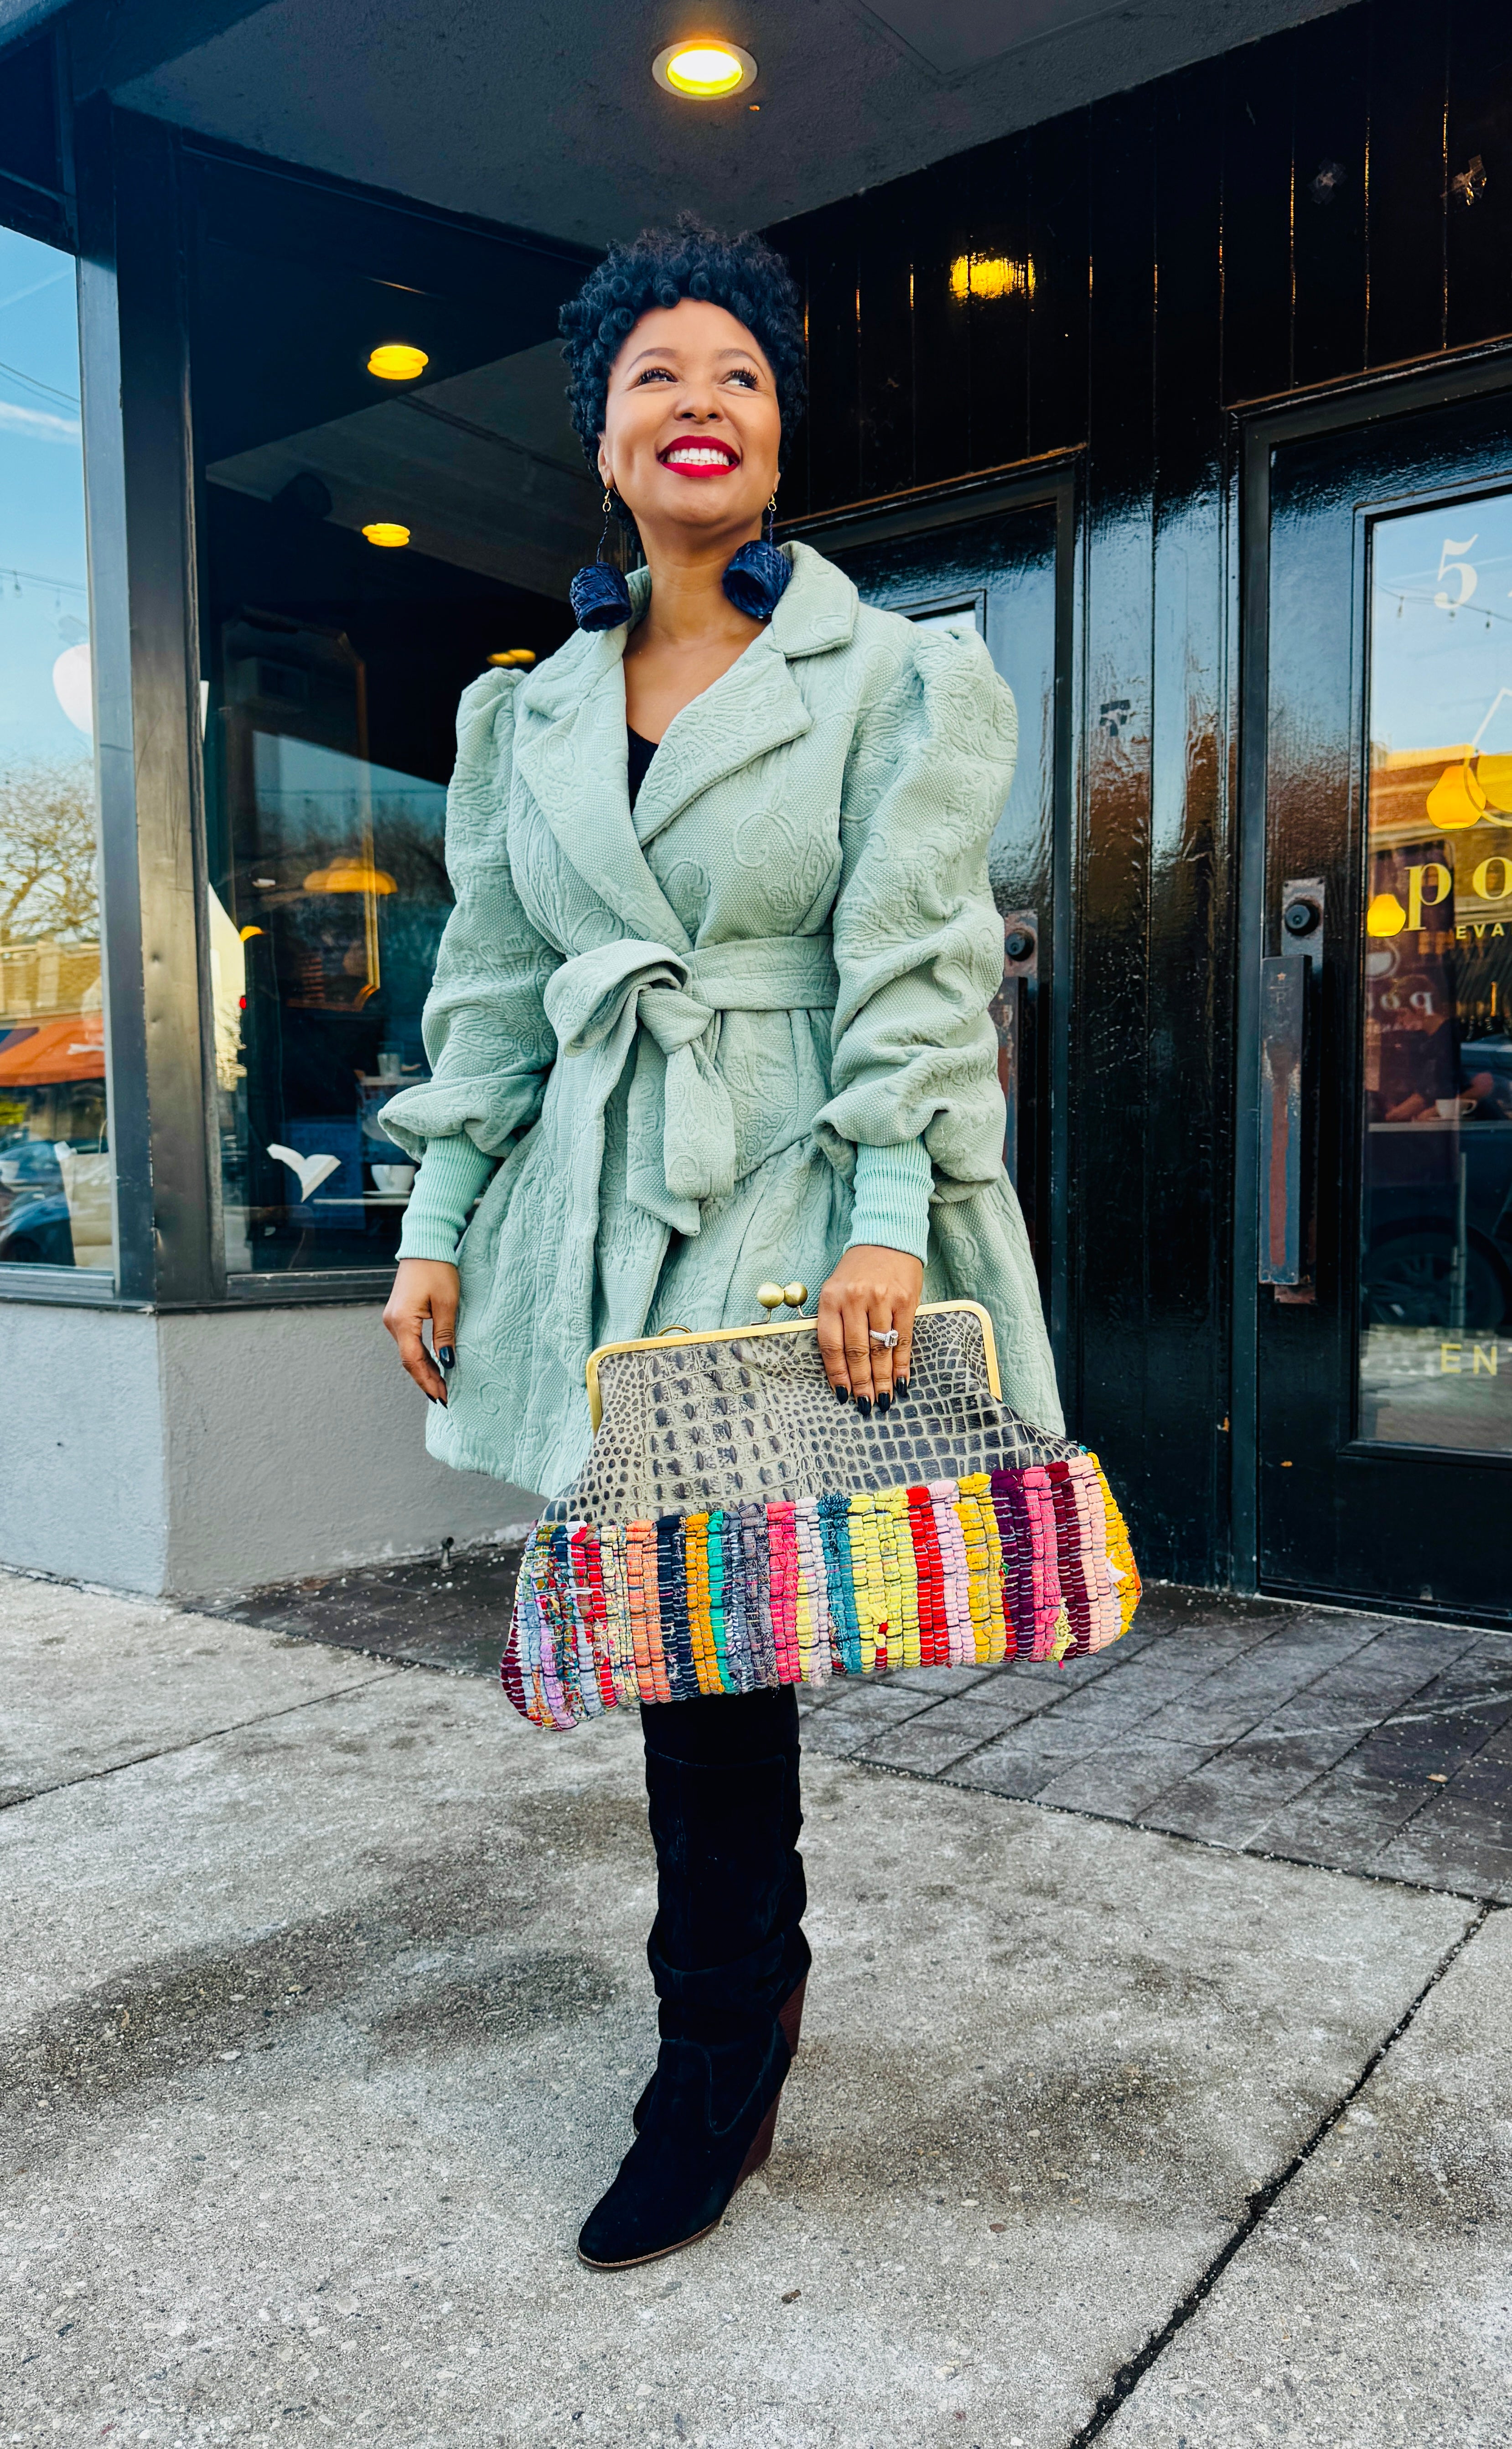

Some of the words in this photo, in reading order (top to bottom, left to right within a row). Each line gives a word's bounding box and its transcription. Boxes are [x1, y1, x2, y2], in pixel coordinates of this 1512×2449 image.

[1434, 534, 1512, 609] 5
[1403, 856, 1512, 931] po
[1456, 923, 1512, 939] EVA
[1440, 1343, 1512, 1376] EN
